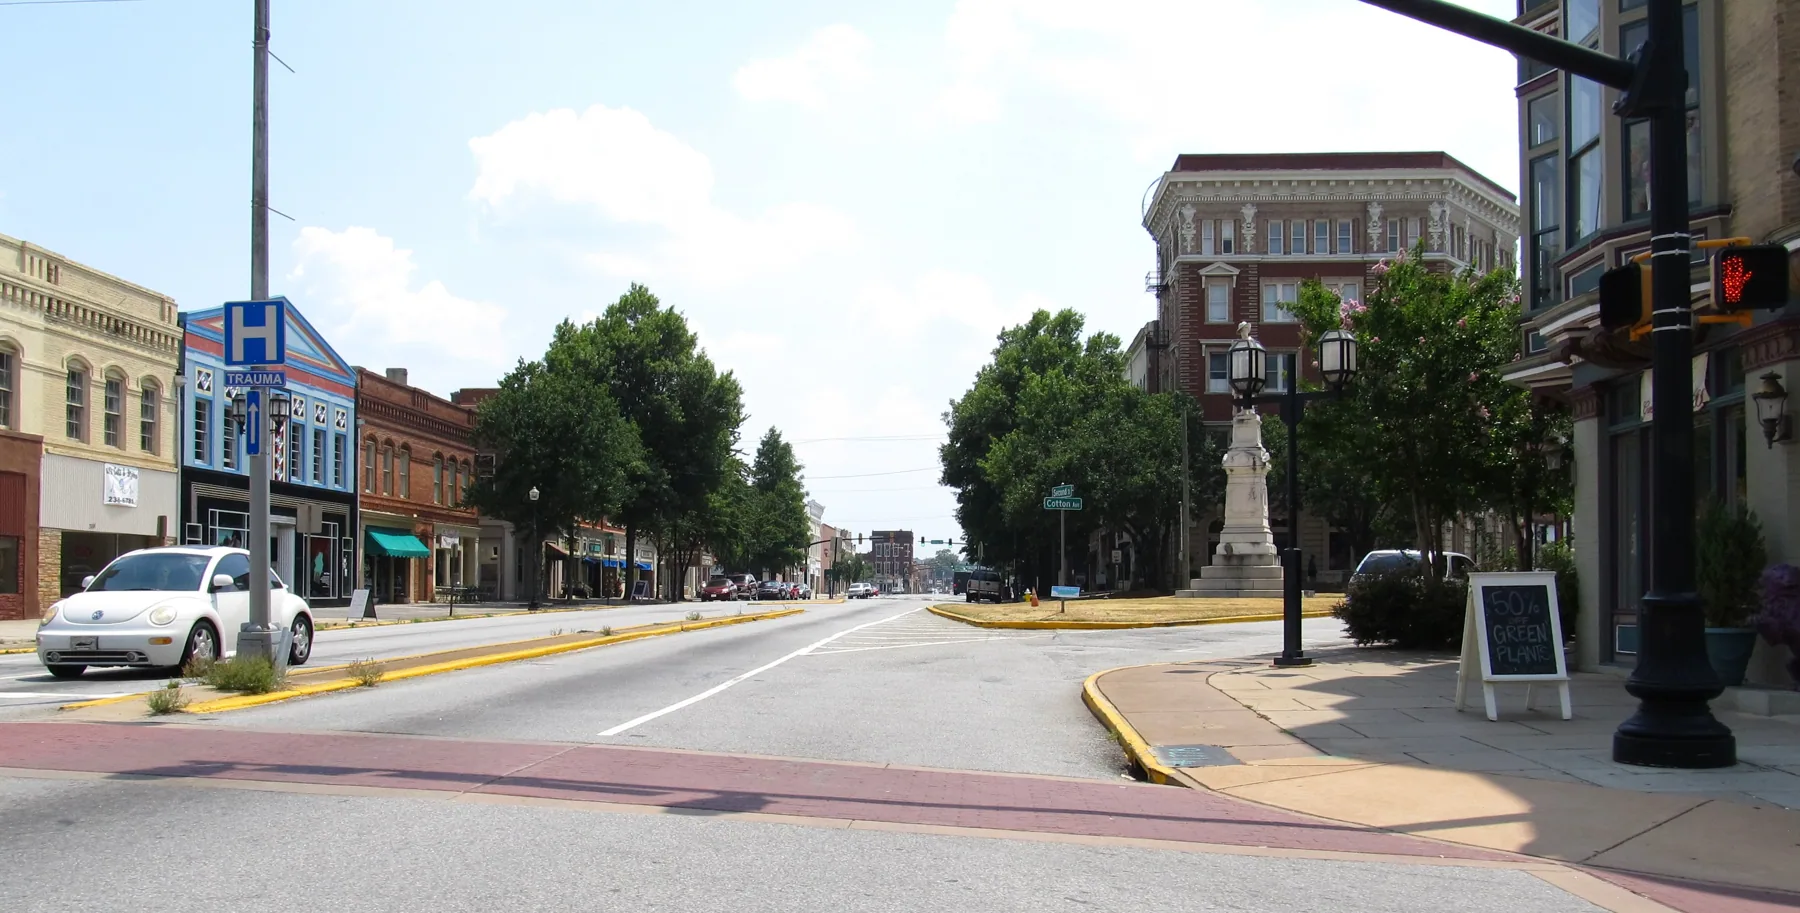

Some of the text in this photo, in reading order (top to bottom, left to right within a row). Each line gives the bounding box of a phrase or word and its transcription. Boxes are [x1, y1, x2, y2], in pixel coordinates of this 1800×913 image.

[232, 305, 277, 361] H
[227, 373, 282, 385] TRAUMA
[1046, 499, 1071, 508] Cotton
[1491, 590, 1540, 615] 50%
[1493, 623, 1548, 645] GREEN
[1496, 644, 1550, 664] PLANTS
